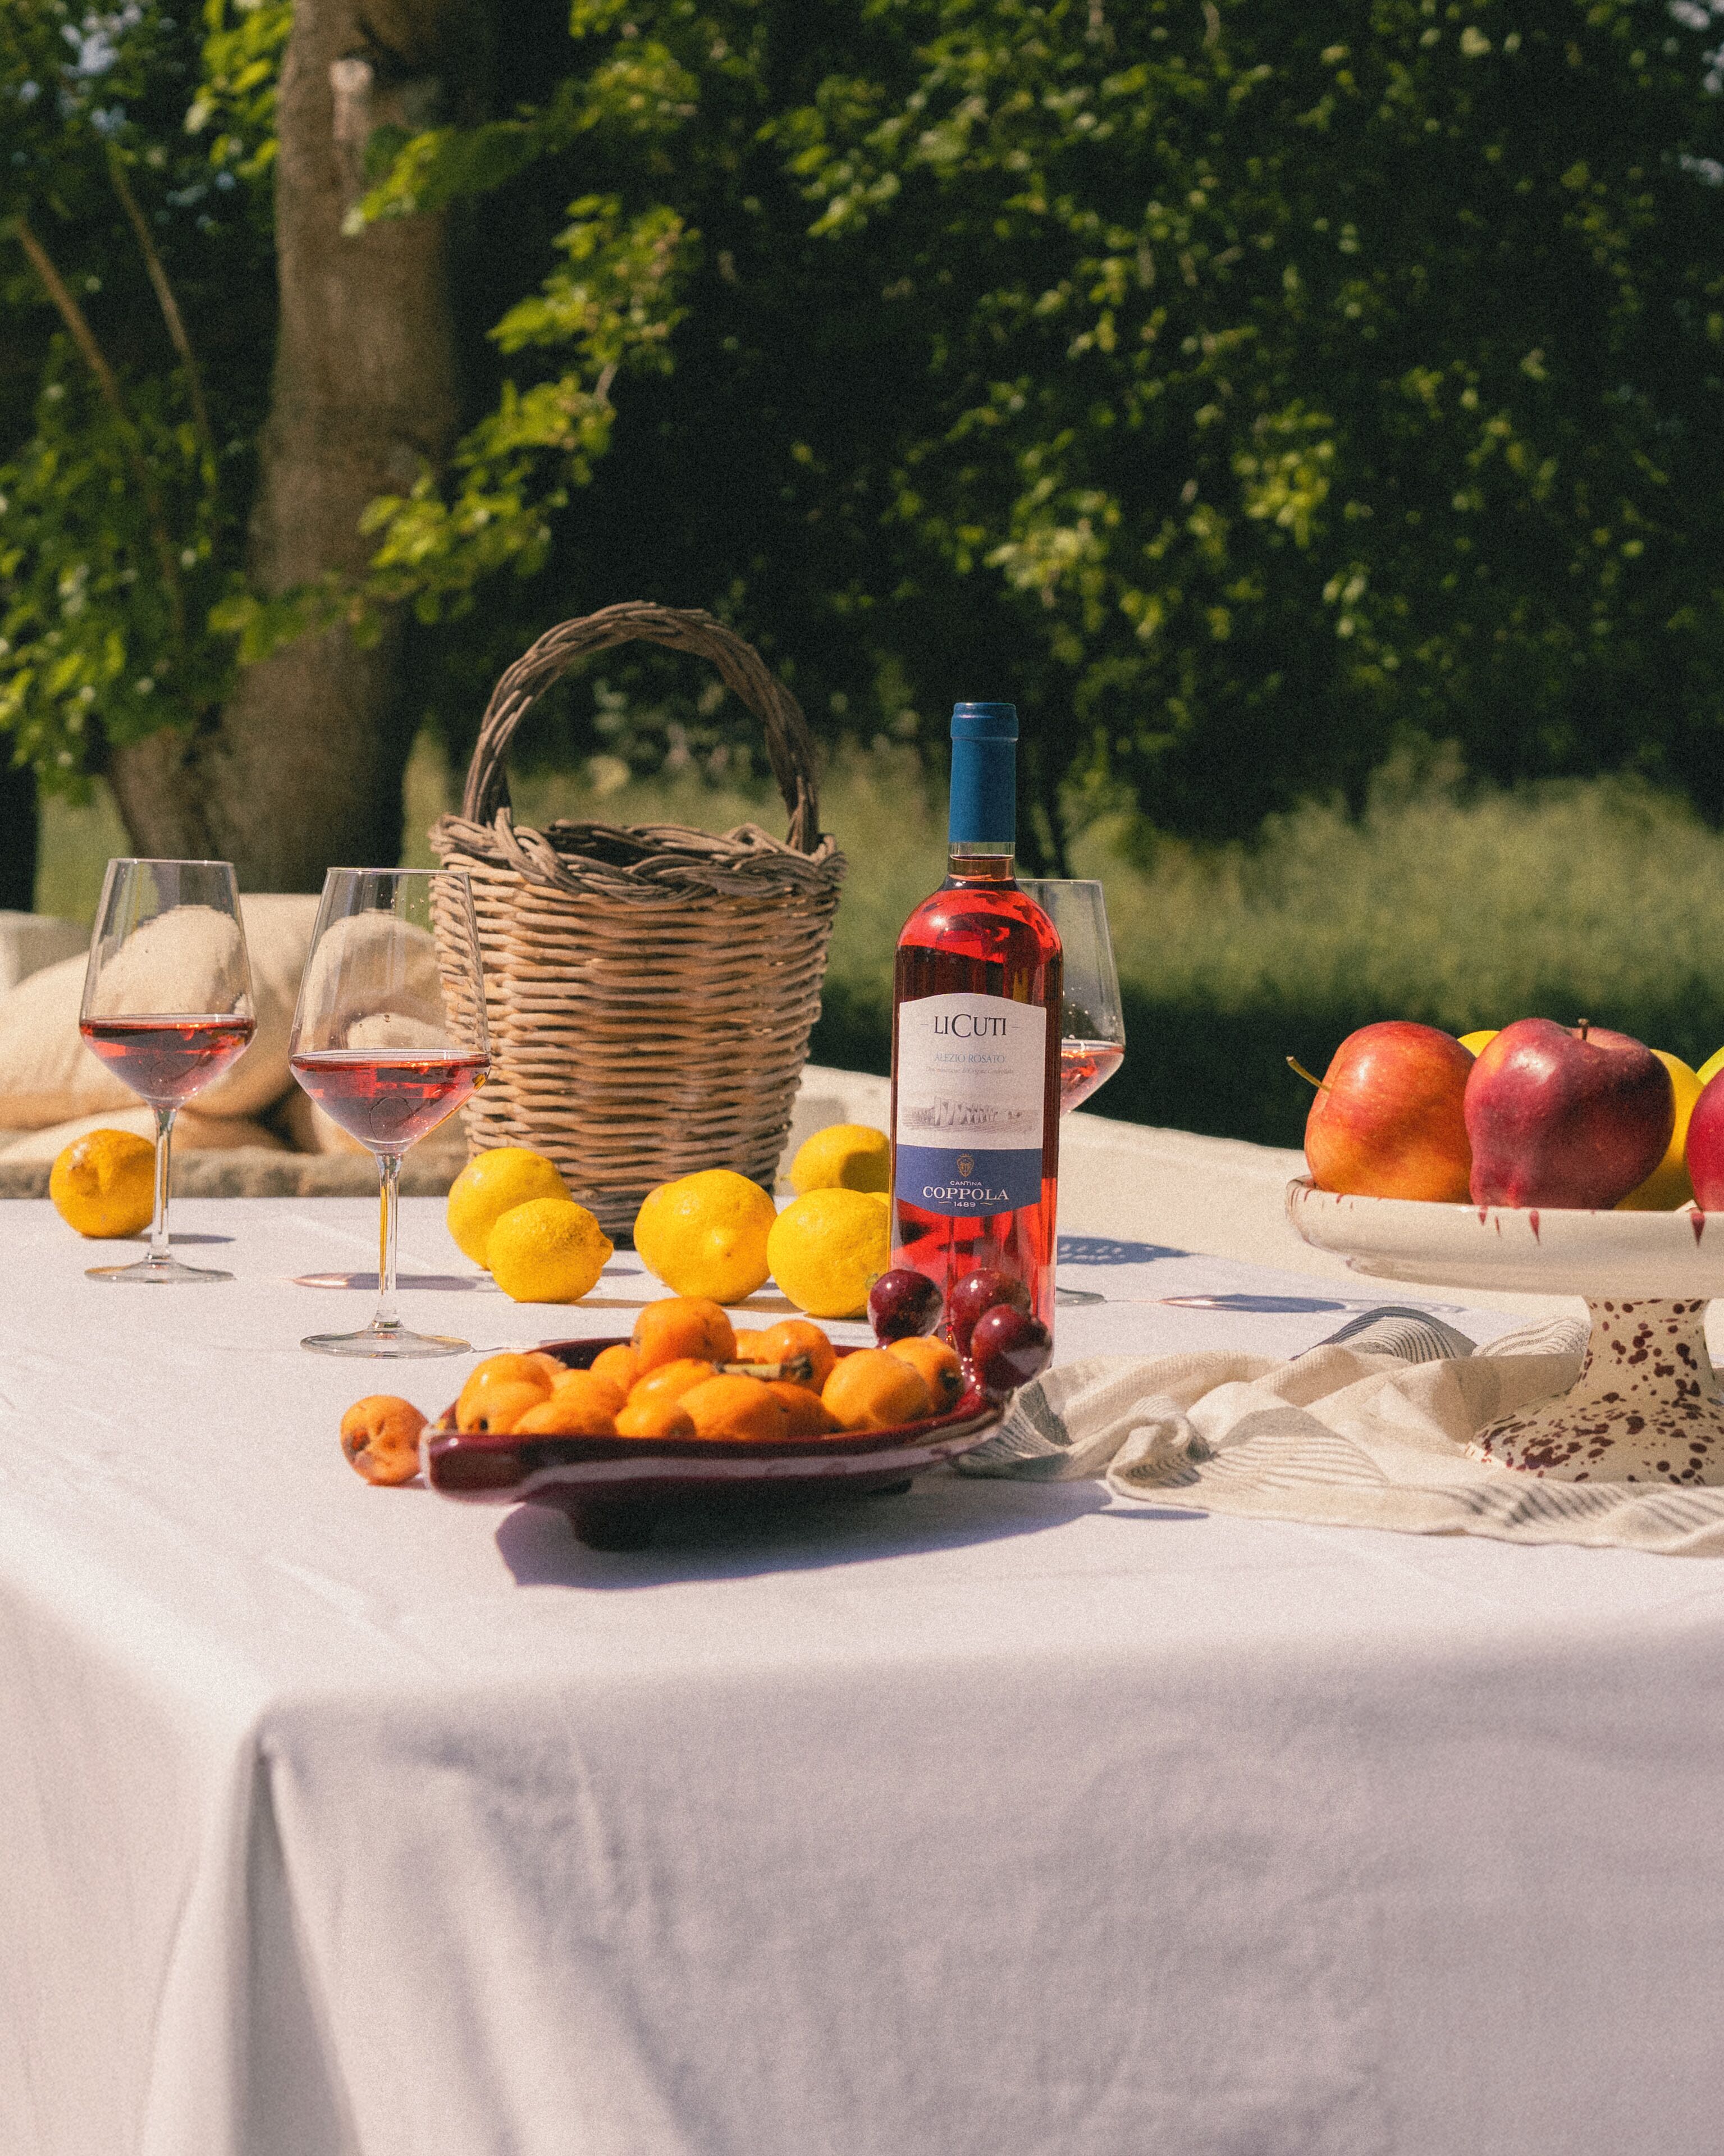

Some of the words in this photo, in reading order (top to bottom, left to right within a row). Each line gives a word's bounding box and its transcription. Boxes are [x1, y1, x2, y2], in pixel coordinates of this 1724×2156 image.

[934, 1053, 966, 1063] ALEZIO
[968, 1054, 1005, 1064] ROSATO
[923, 1186, 1009, 1200] COPPOLA
